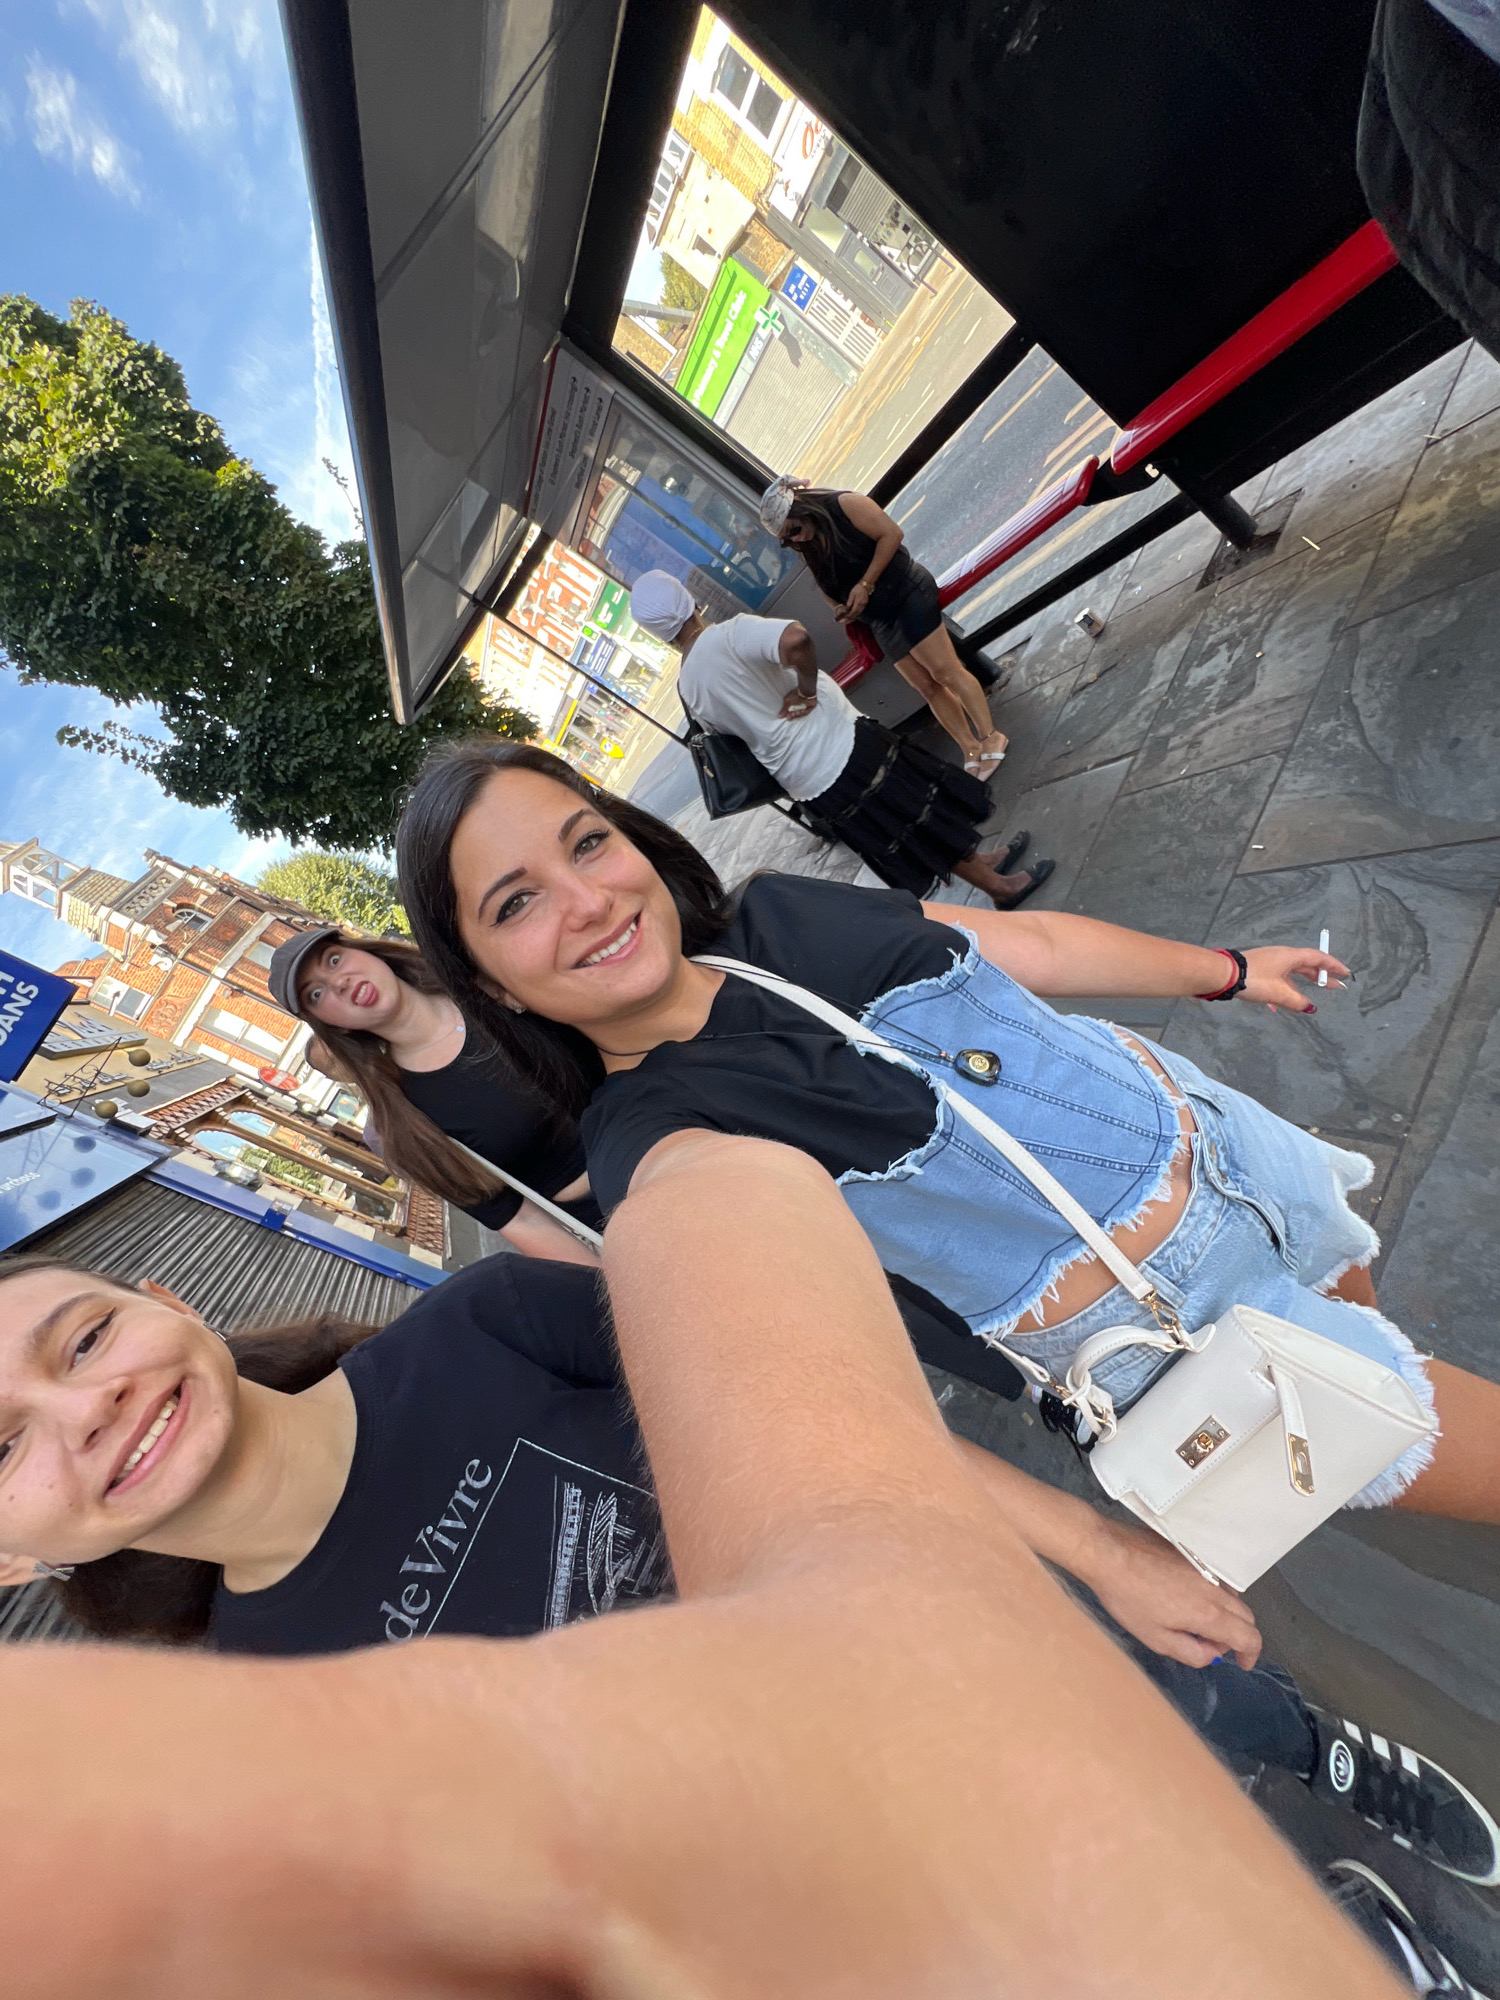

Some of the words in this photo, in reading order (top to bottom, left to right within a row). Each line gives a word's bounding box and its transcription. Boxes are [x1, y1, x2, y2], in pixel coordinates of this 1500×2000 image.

[728, 289, 747, 320] Clinic
[748, 337, 763, 360] NHS
[400, 1458, 492, 1574] Vivre
[379, 1583, 431, 1642] de
